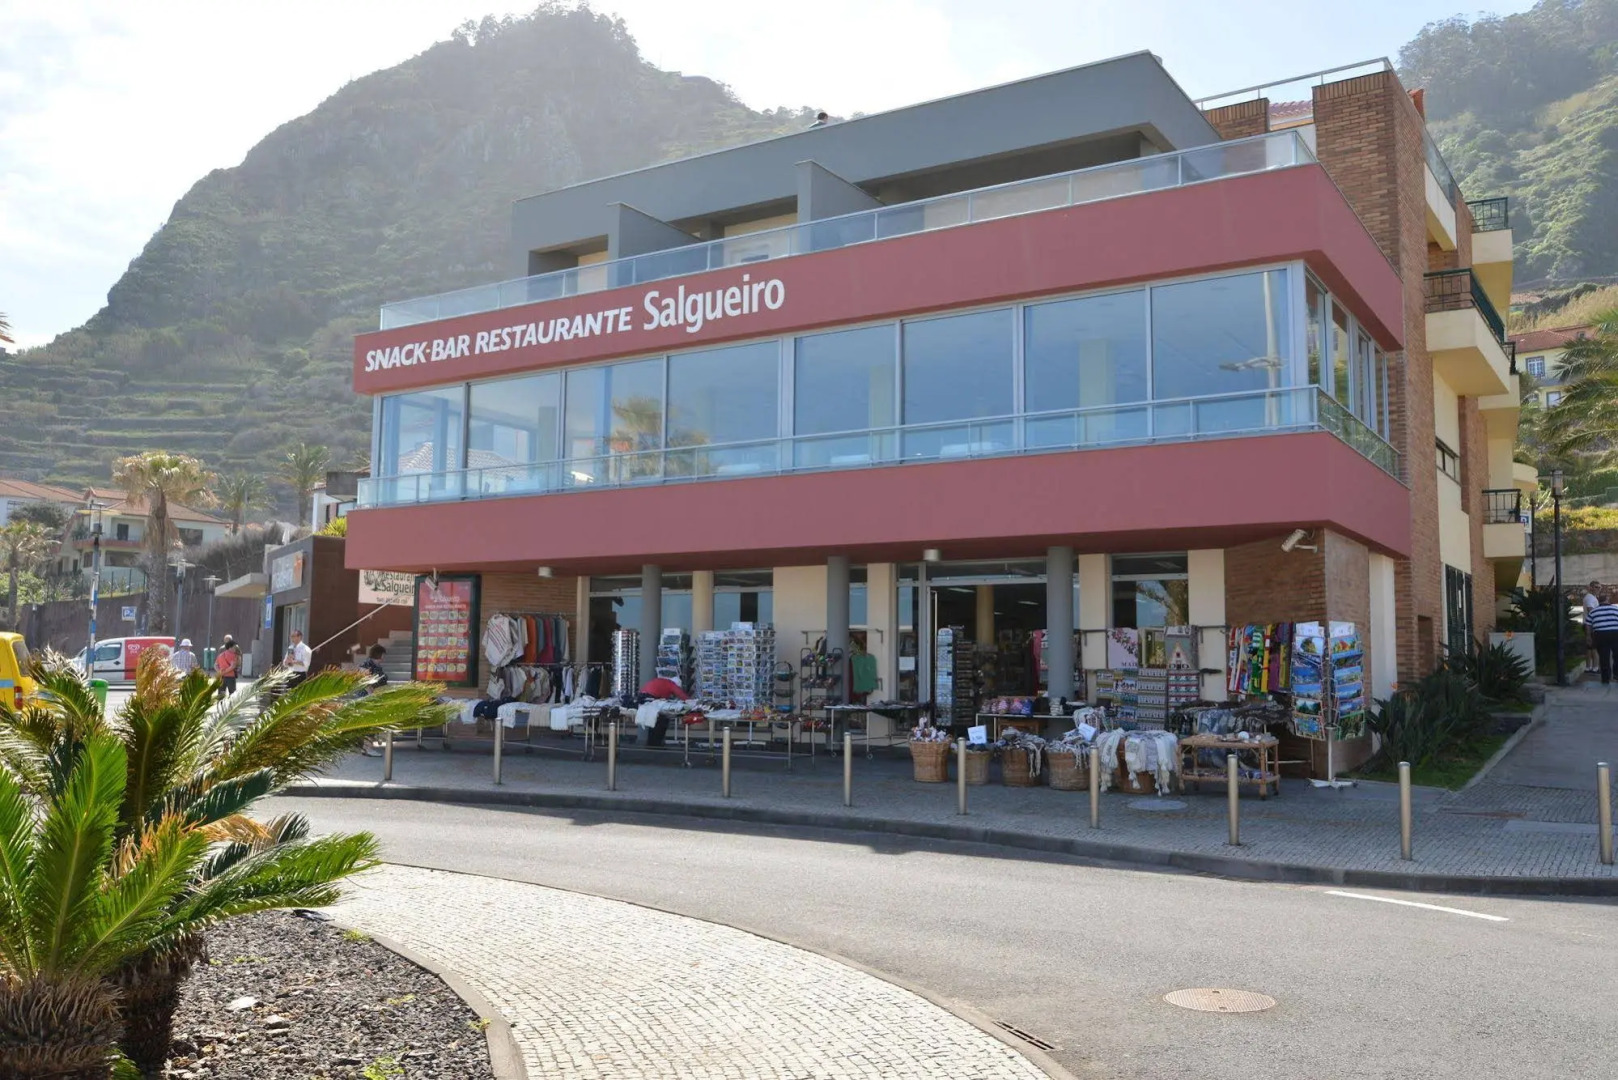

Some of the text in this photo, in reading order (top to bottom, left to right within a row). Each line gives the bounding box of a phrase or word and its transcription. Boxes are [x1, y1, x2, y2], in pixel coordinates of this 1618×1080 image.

[365, 273, 785, 372] SNACK-BAR RESTAURANTE Salgueiro
